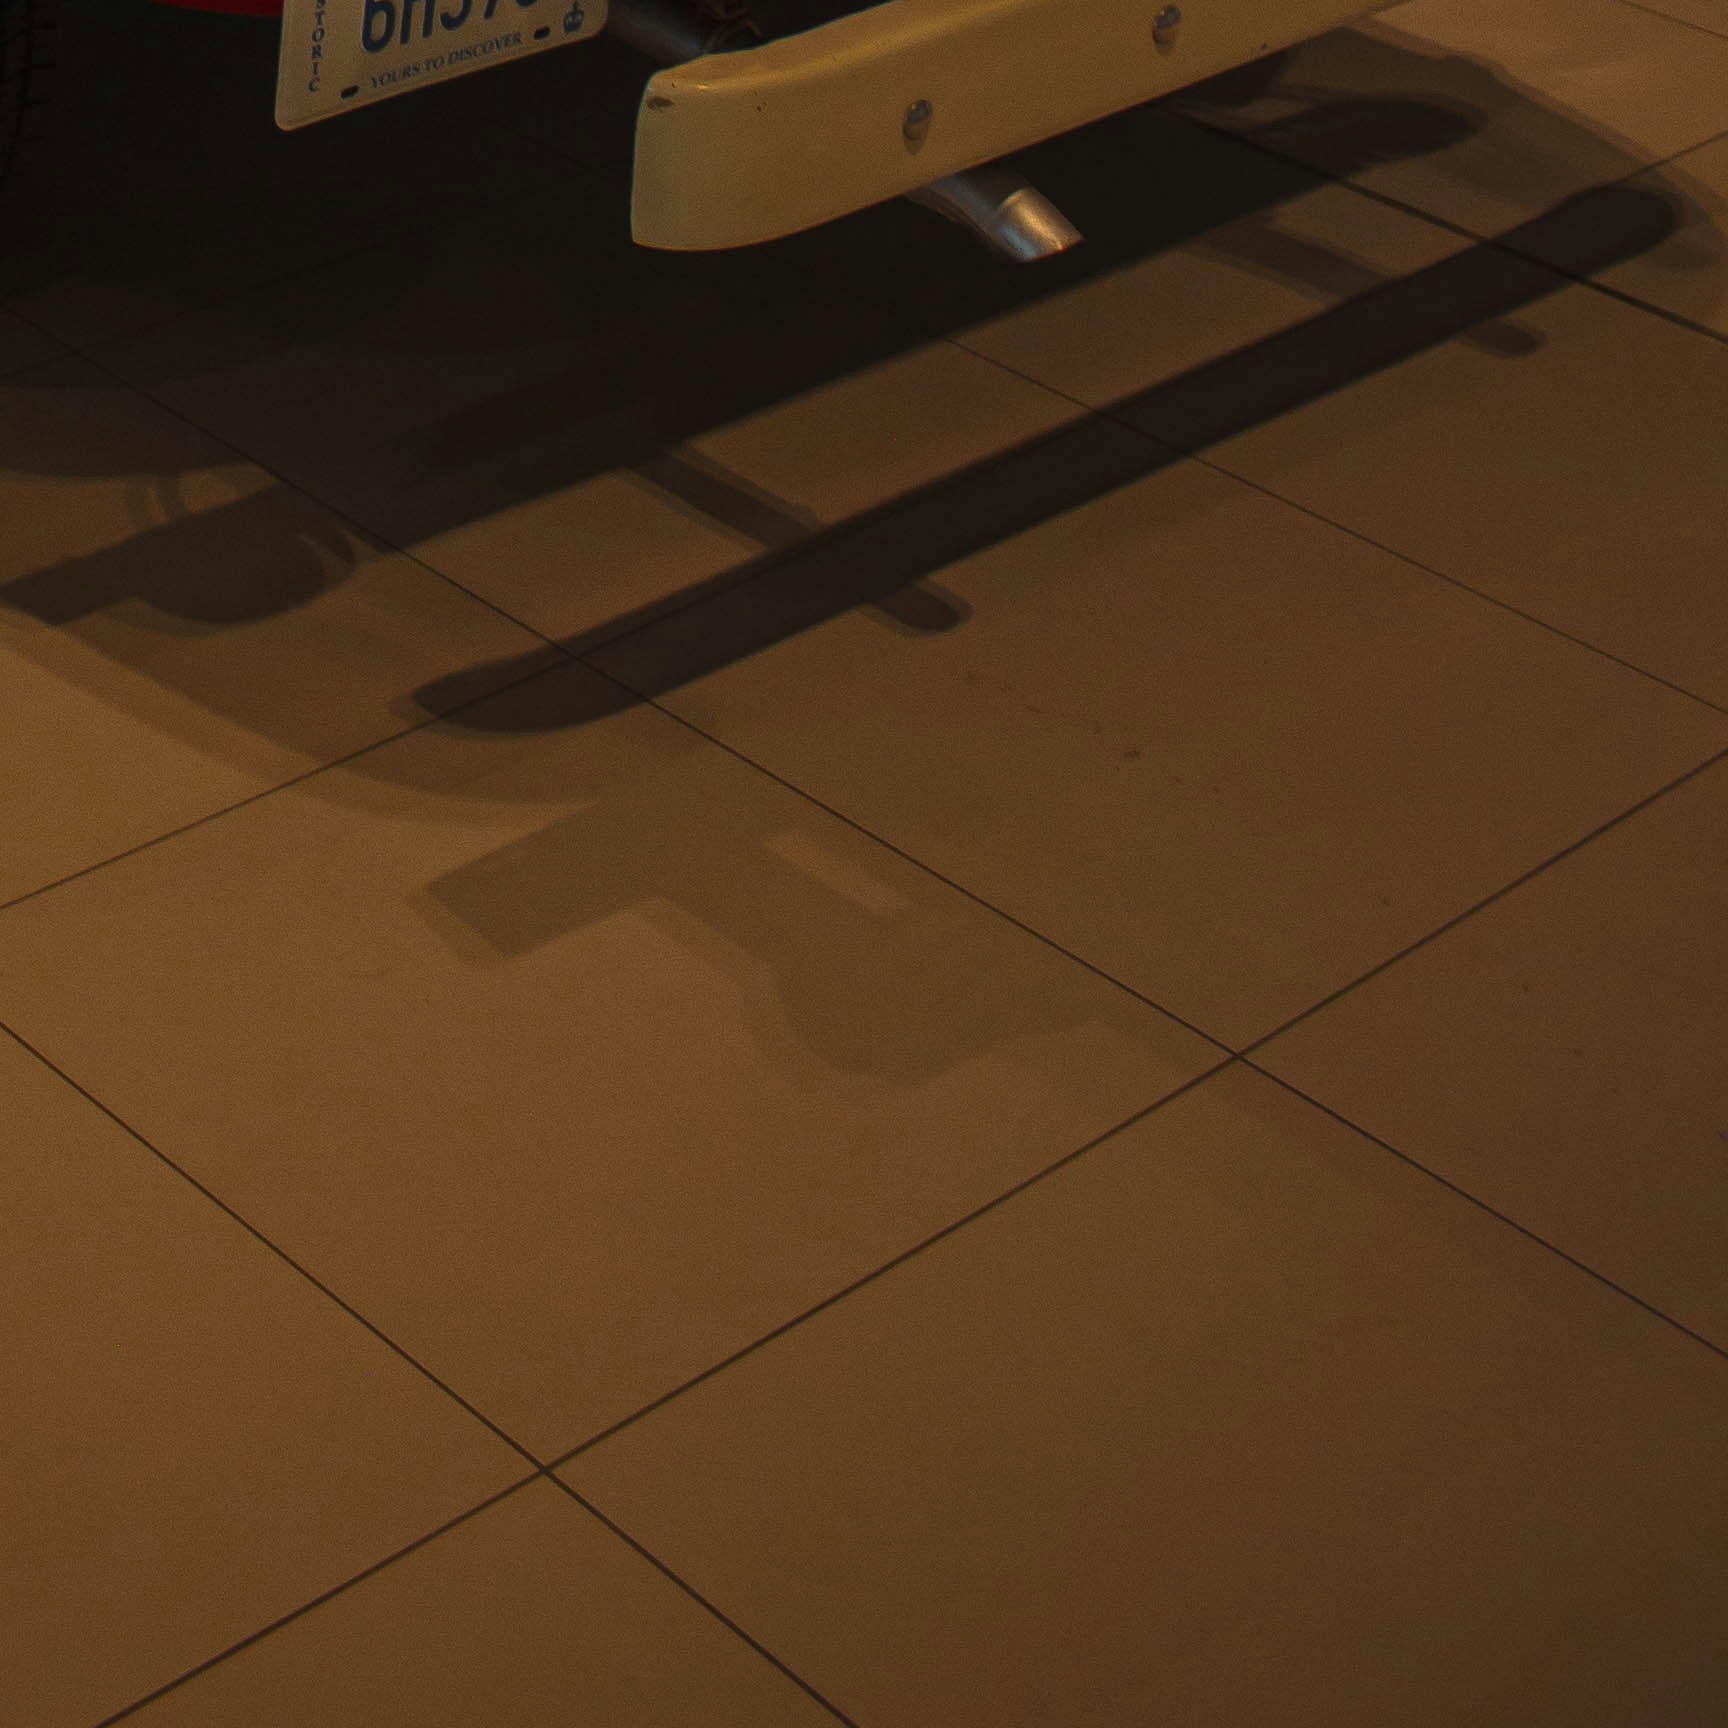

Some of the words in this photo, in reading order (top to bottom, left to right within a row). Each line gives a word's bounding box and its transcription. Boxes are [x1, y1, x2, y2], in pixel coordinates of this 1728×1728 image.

[371, 62, 420, 88] YOURS
[423, 55, 445, 70] TO
[448, 31, 521, 64] DISCOVER
